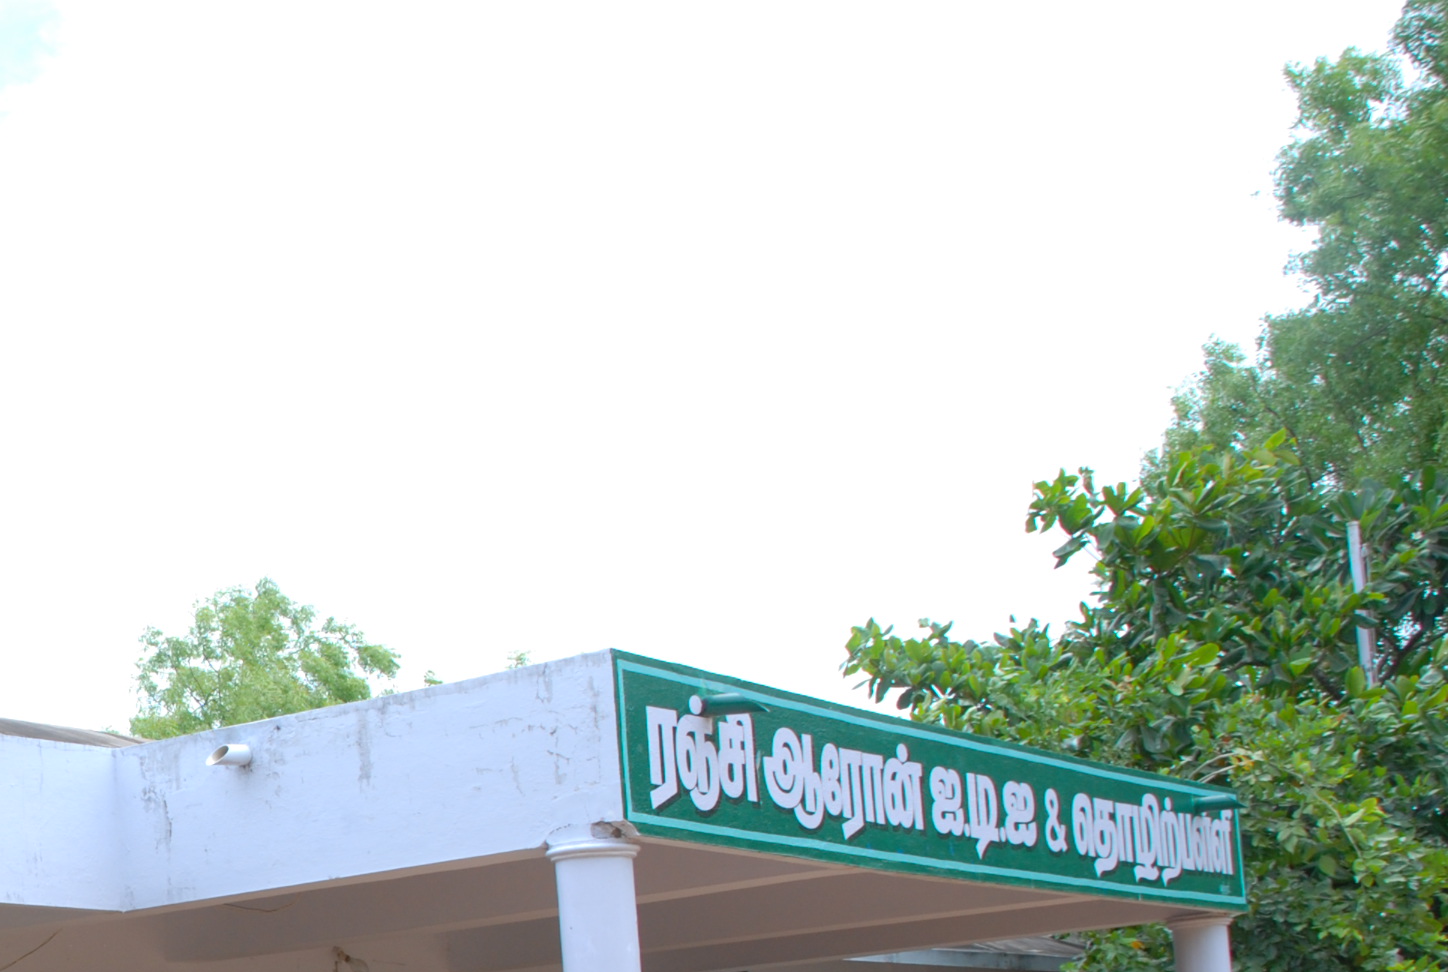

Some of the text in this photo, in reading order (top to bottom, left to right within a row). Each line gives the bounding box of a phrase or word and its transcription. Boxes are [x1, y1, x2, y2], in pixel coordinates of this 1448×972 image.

[645, 694, 759, 812] ரஞ்சி
[762, 726, 925, 840] ஆரோன்
[1044, 787, 1069, 853] &
